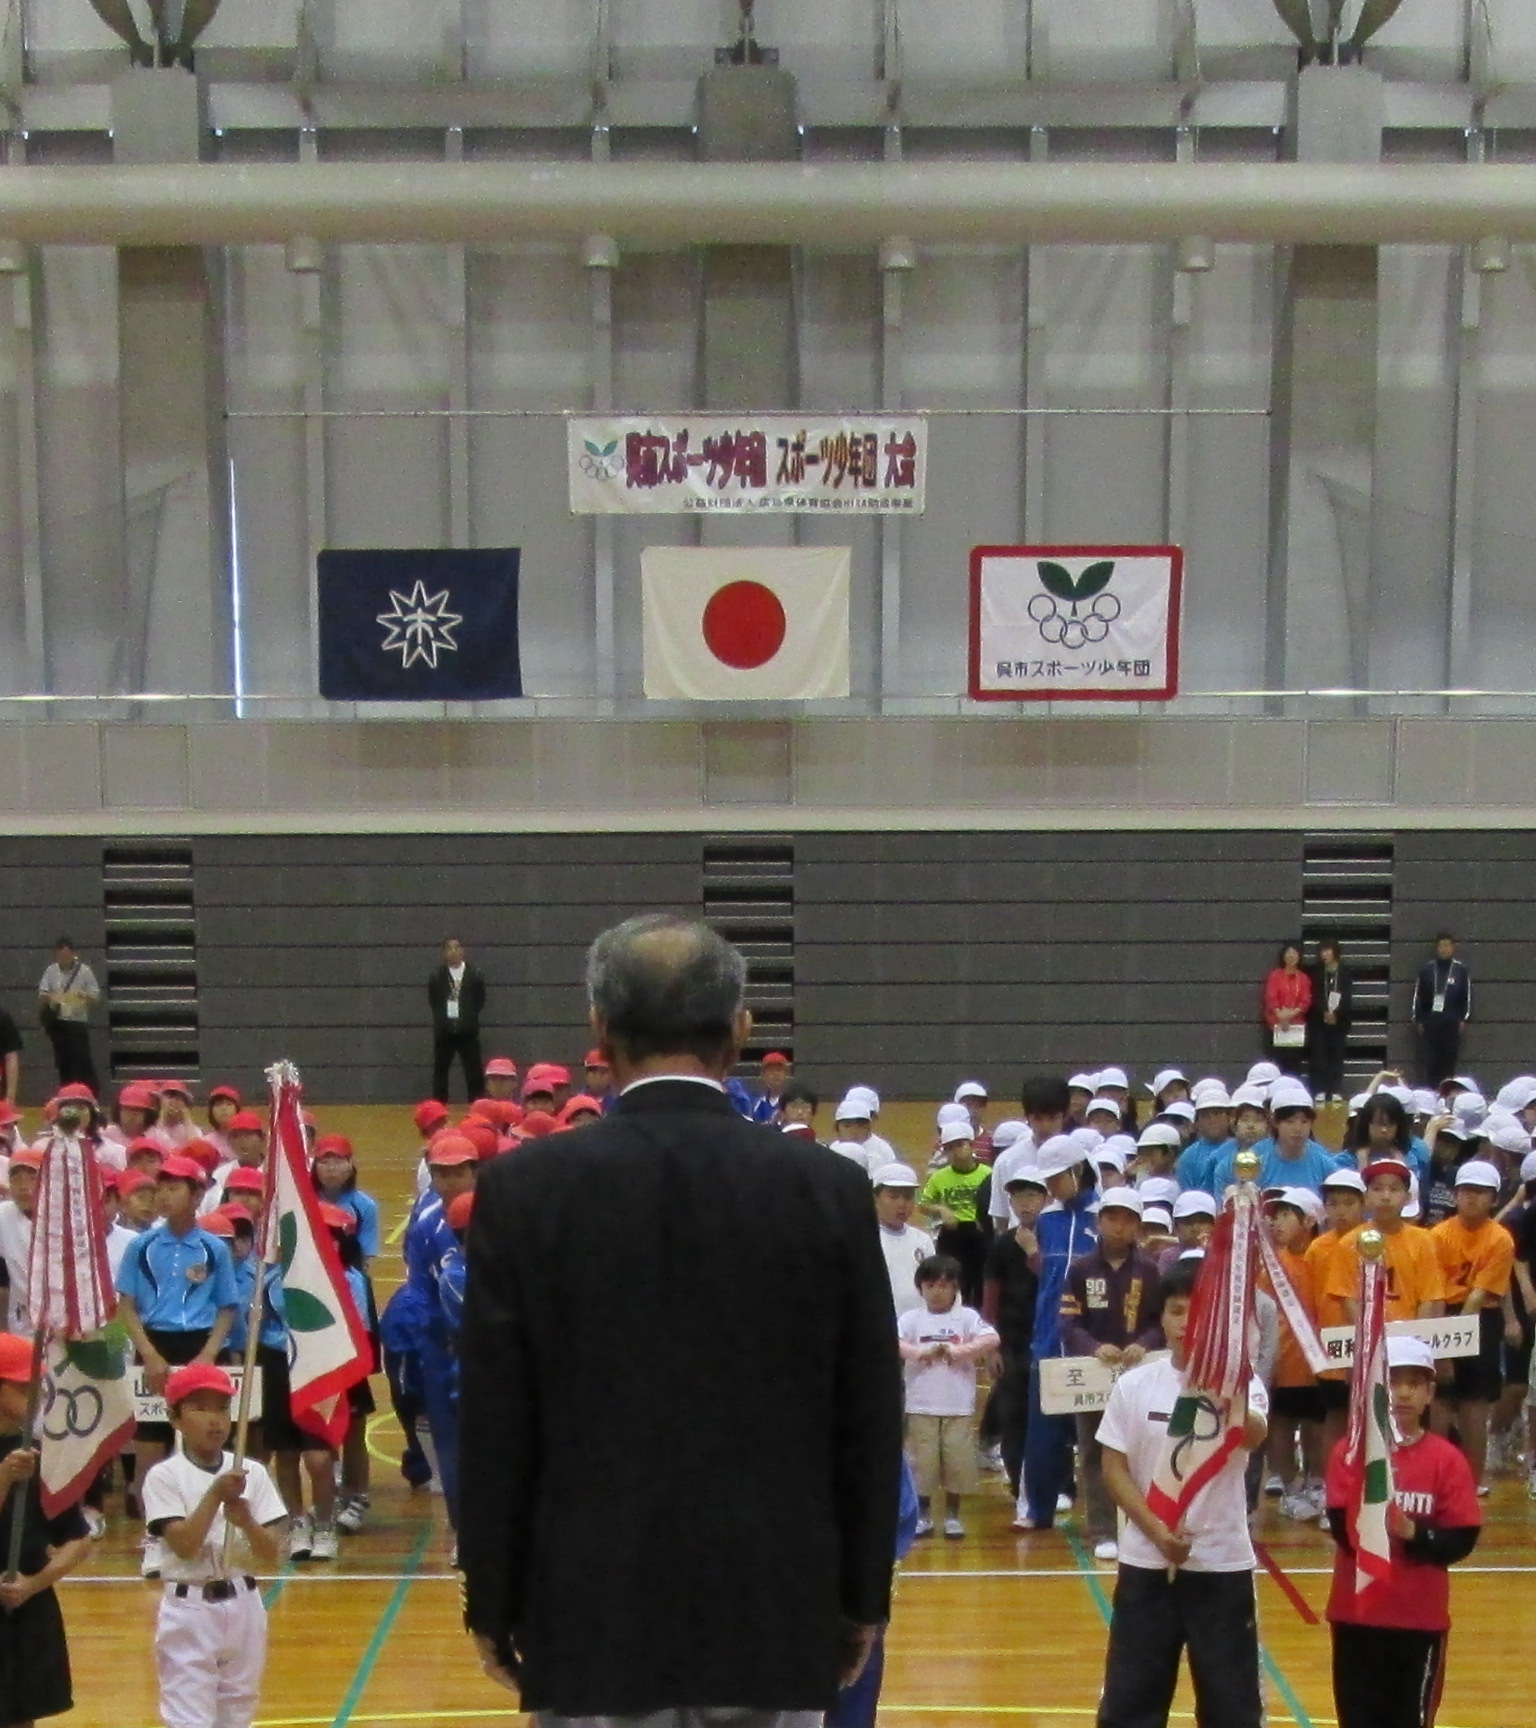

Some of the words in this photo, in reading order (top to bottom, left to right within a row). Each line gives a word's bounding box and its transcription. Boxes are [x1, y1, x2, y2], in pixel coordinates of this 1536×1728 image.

[884, 431, 917, 488] 大会
[996, 658, 1150, 678] 呉市スポーツ少年団
